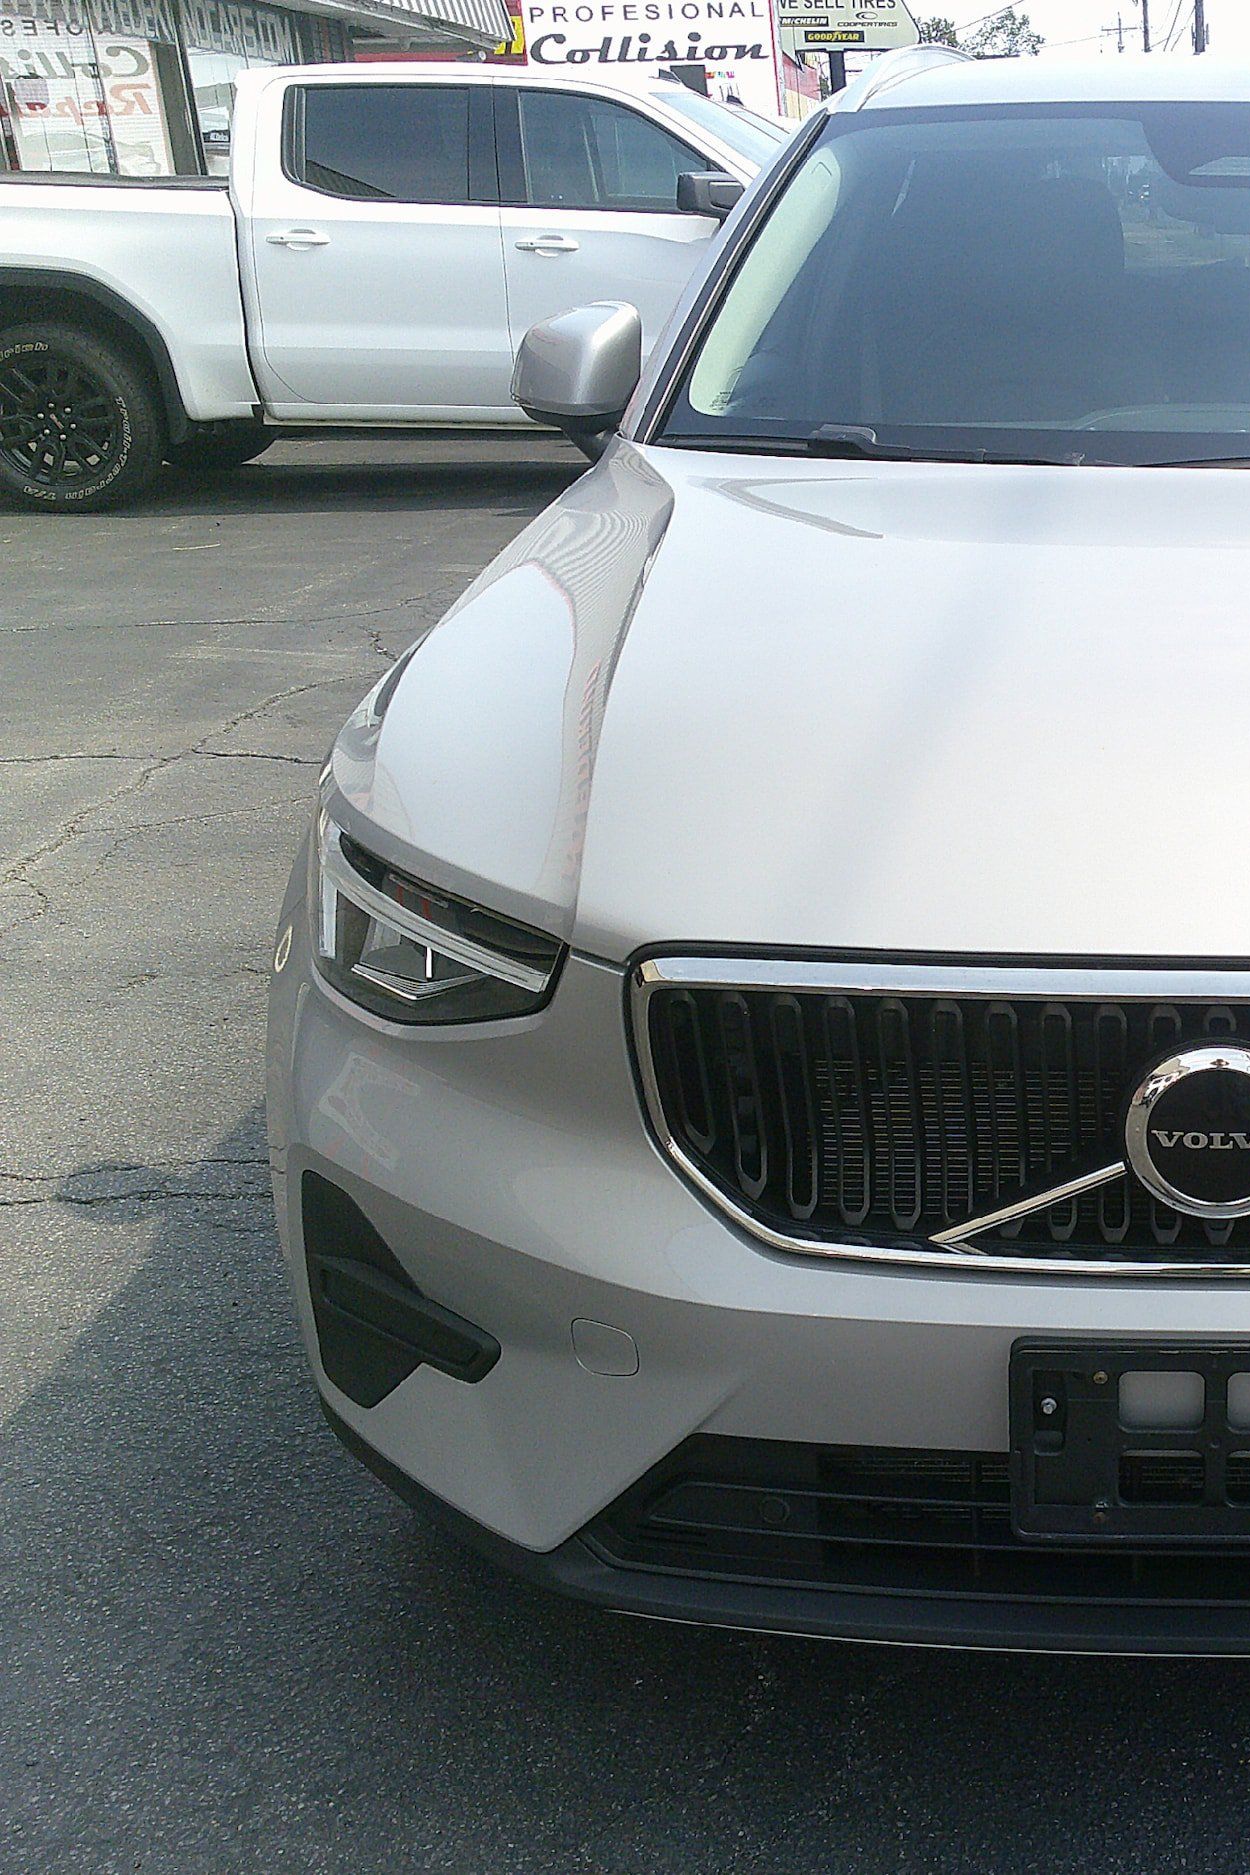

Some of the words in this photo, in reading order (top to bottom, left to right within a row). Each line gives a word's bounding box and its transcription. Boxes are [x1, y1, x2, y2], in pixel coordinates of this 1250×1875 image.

[804, 0, 845, 9] SELL
[850, 0, 896, 9] TIRES
[529, 2, 764, 23] PROFESIONAL
[781, 17, 827, 26] MICHELIN
[807, 31, 860, 41] GOODYEAR
[530, 32, 769, 65] Collision
